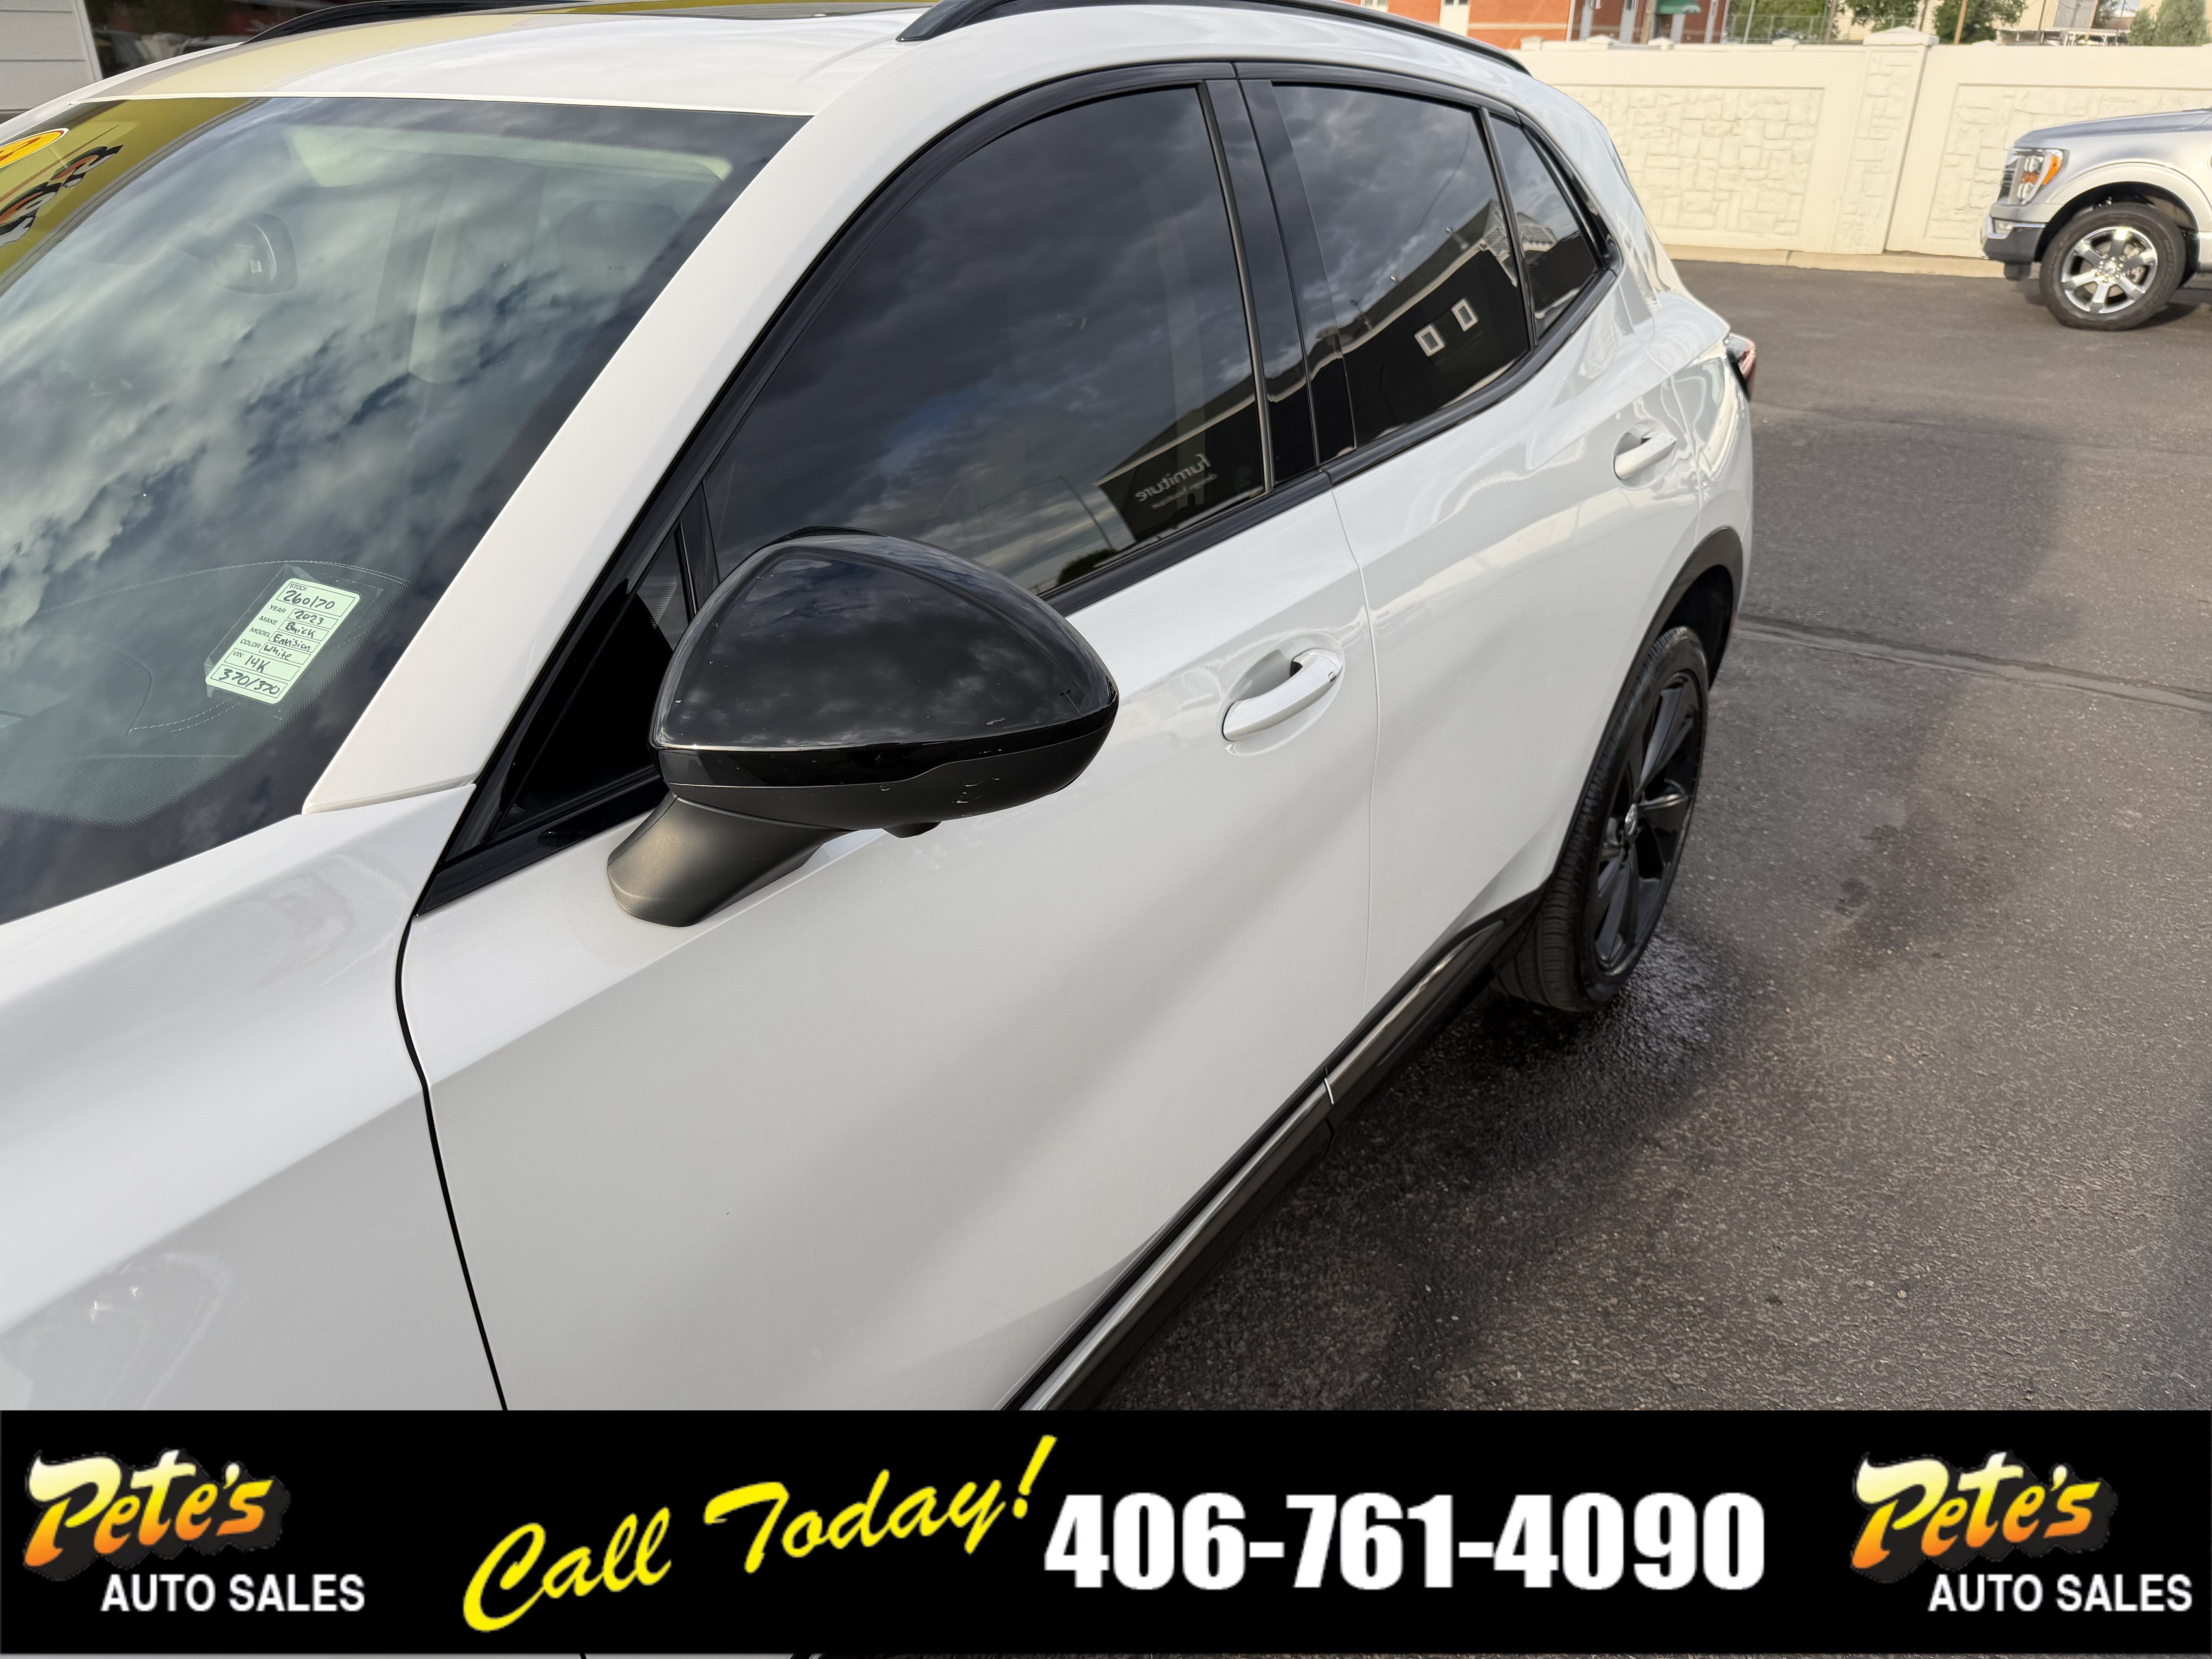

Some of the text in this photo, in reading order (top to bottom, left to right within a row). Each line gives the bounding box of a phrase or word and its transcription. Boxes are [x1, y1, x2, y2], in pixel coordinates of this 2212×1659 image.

[290, 583, 308, 592] STOCK
[270, 605, 286, 613] YEAR
[259, 616, 278, 625] MAKE
[294, 611, 324, 625] 2023
[249, 627, 270, 638] MODEL
[240, 639, 261, 649] COLOR
[273, 634, 311, 652] Envision
[245, 655, 270, 673] 14K
[219, 668, 280, 695] 370/370
